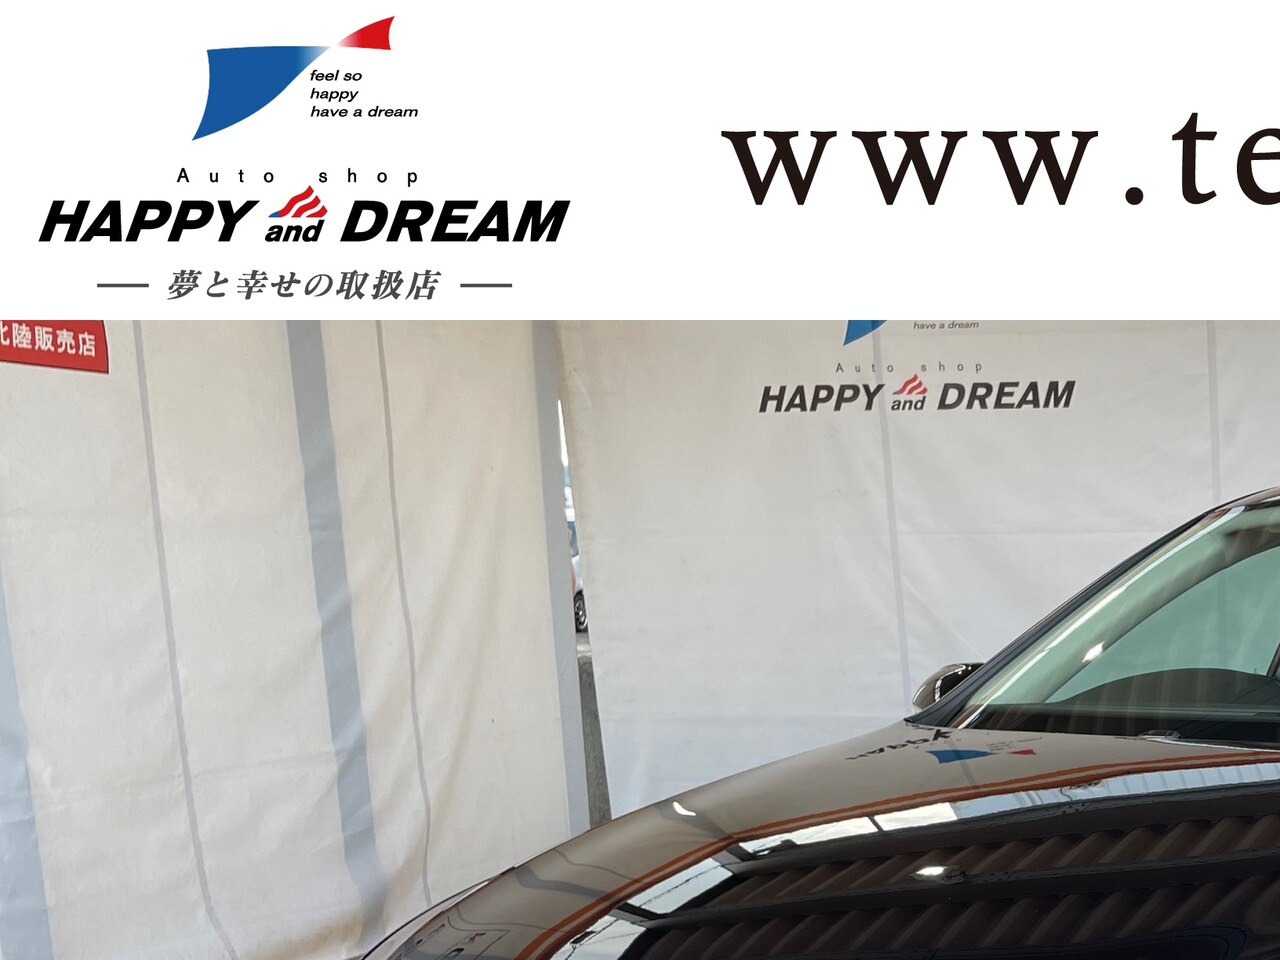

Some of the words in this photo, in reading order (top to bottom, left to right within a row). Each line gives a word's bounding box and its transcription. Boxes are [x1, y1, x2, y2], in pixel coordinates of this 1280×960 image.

[912, 321, 937, 330] have
[947, 320, 980, 330] dream
[835, 362, 895, 374] Auto
[920, 361, 982, 374] shop
[758, 382, 886, 413] HAPPY
[890, 395, 927, 411] and
[936, 379, 1077, 411] DREAM
